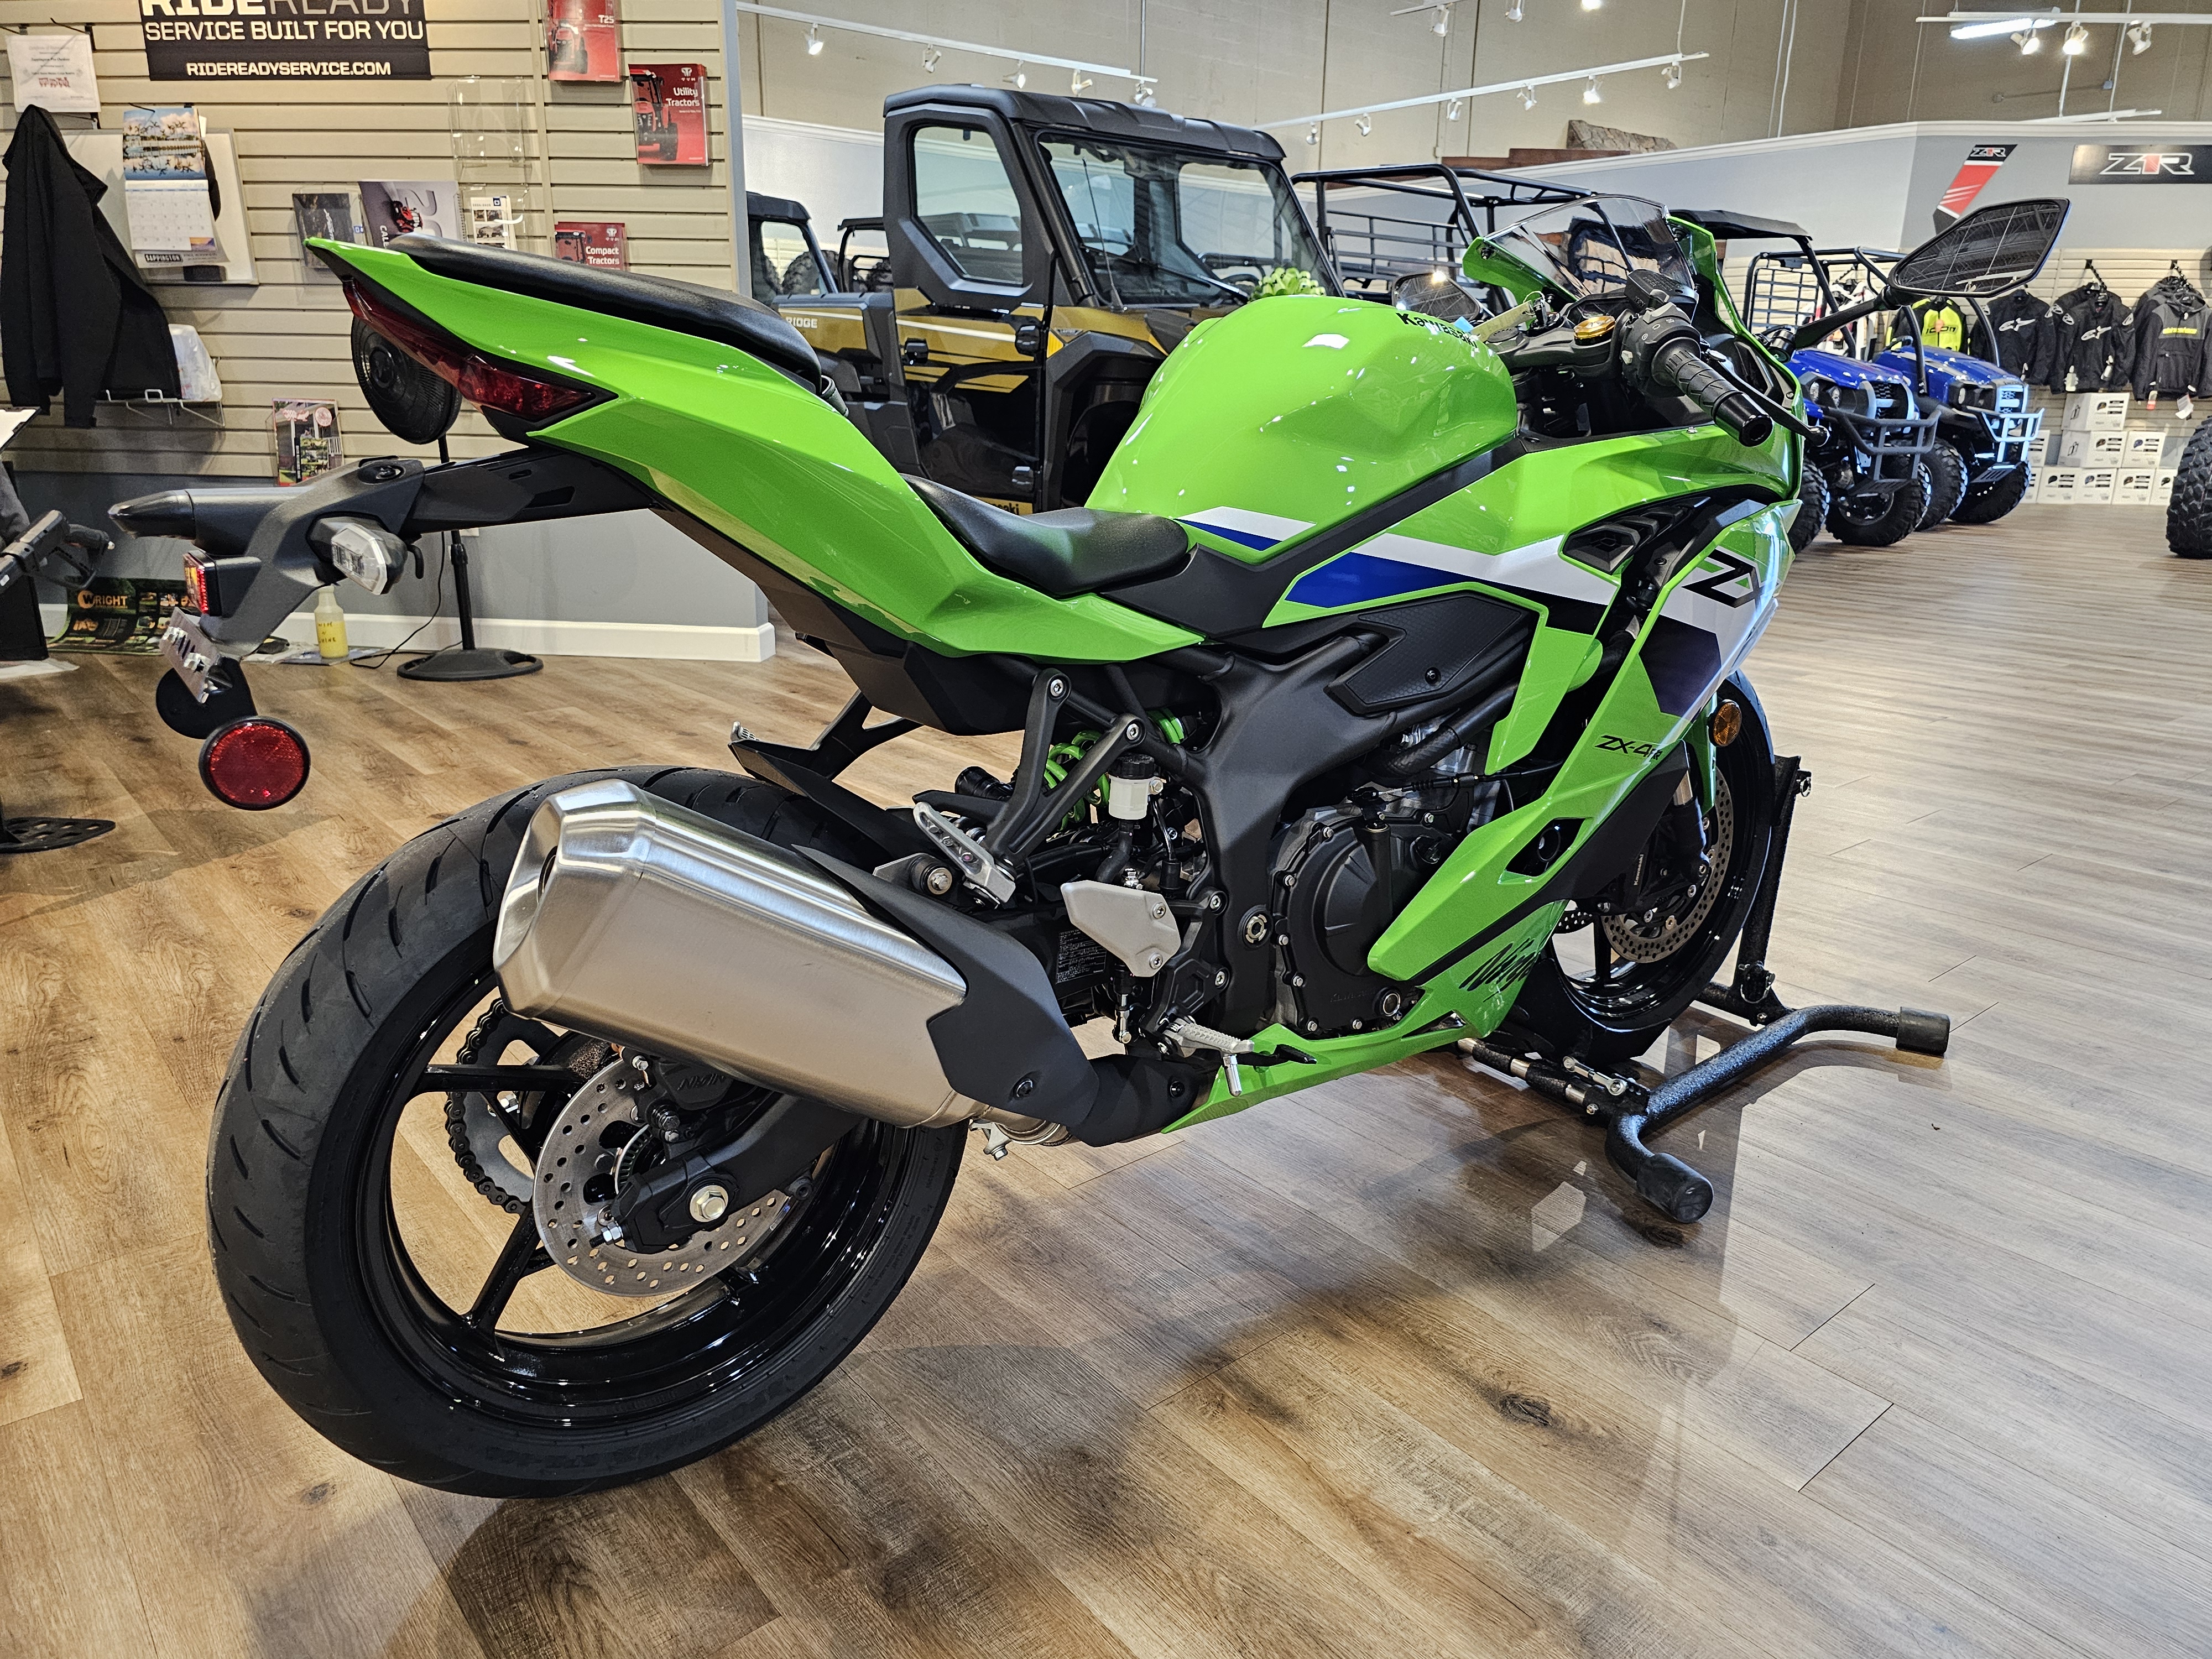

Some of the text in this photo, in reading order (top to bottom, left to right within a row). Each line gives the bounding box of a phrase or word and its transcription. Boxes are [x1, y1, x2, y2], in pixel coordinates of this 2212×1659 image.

[598, 14, 614, 24] T25
[146, 20, 423, 40] SERVICE BUILT FOR YOU
[186, 61, 391, 76] RIDEREADYSERVICE.COM
[673, 87, 698, 97] Utility
[665, 98, 700, 107] Tractors
[586, 246, 619, 256] Compact
[587, 256, 620, 265] Tractors
[81, 593, 128, 606] WRIGHT
